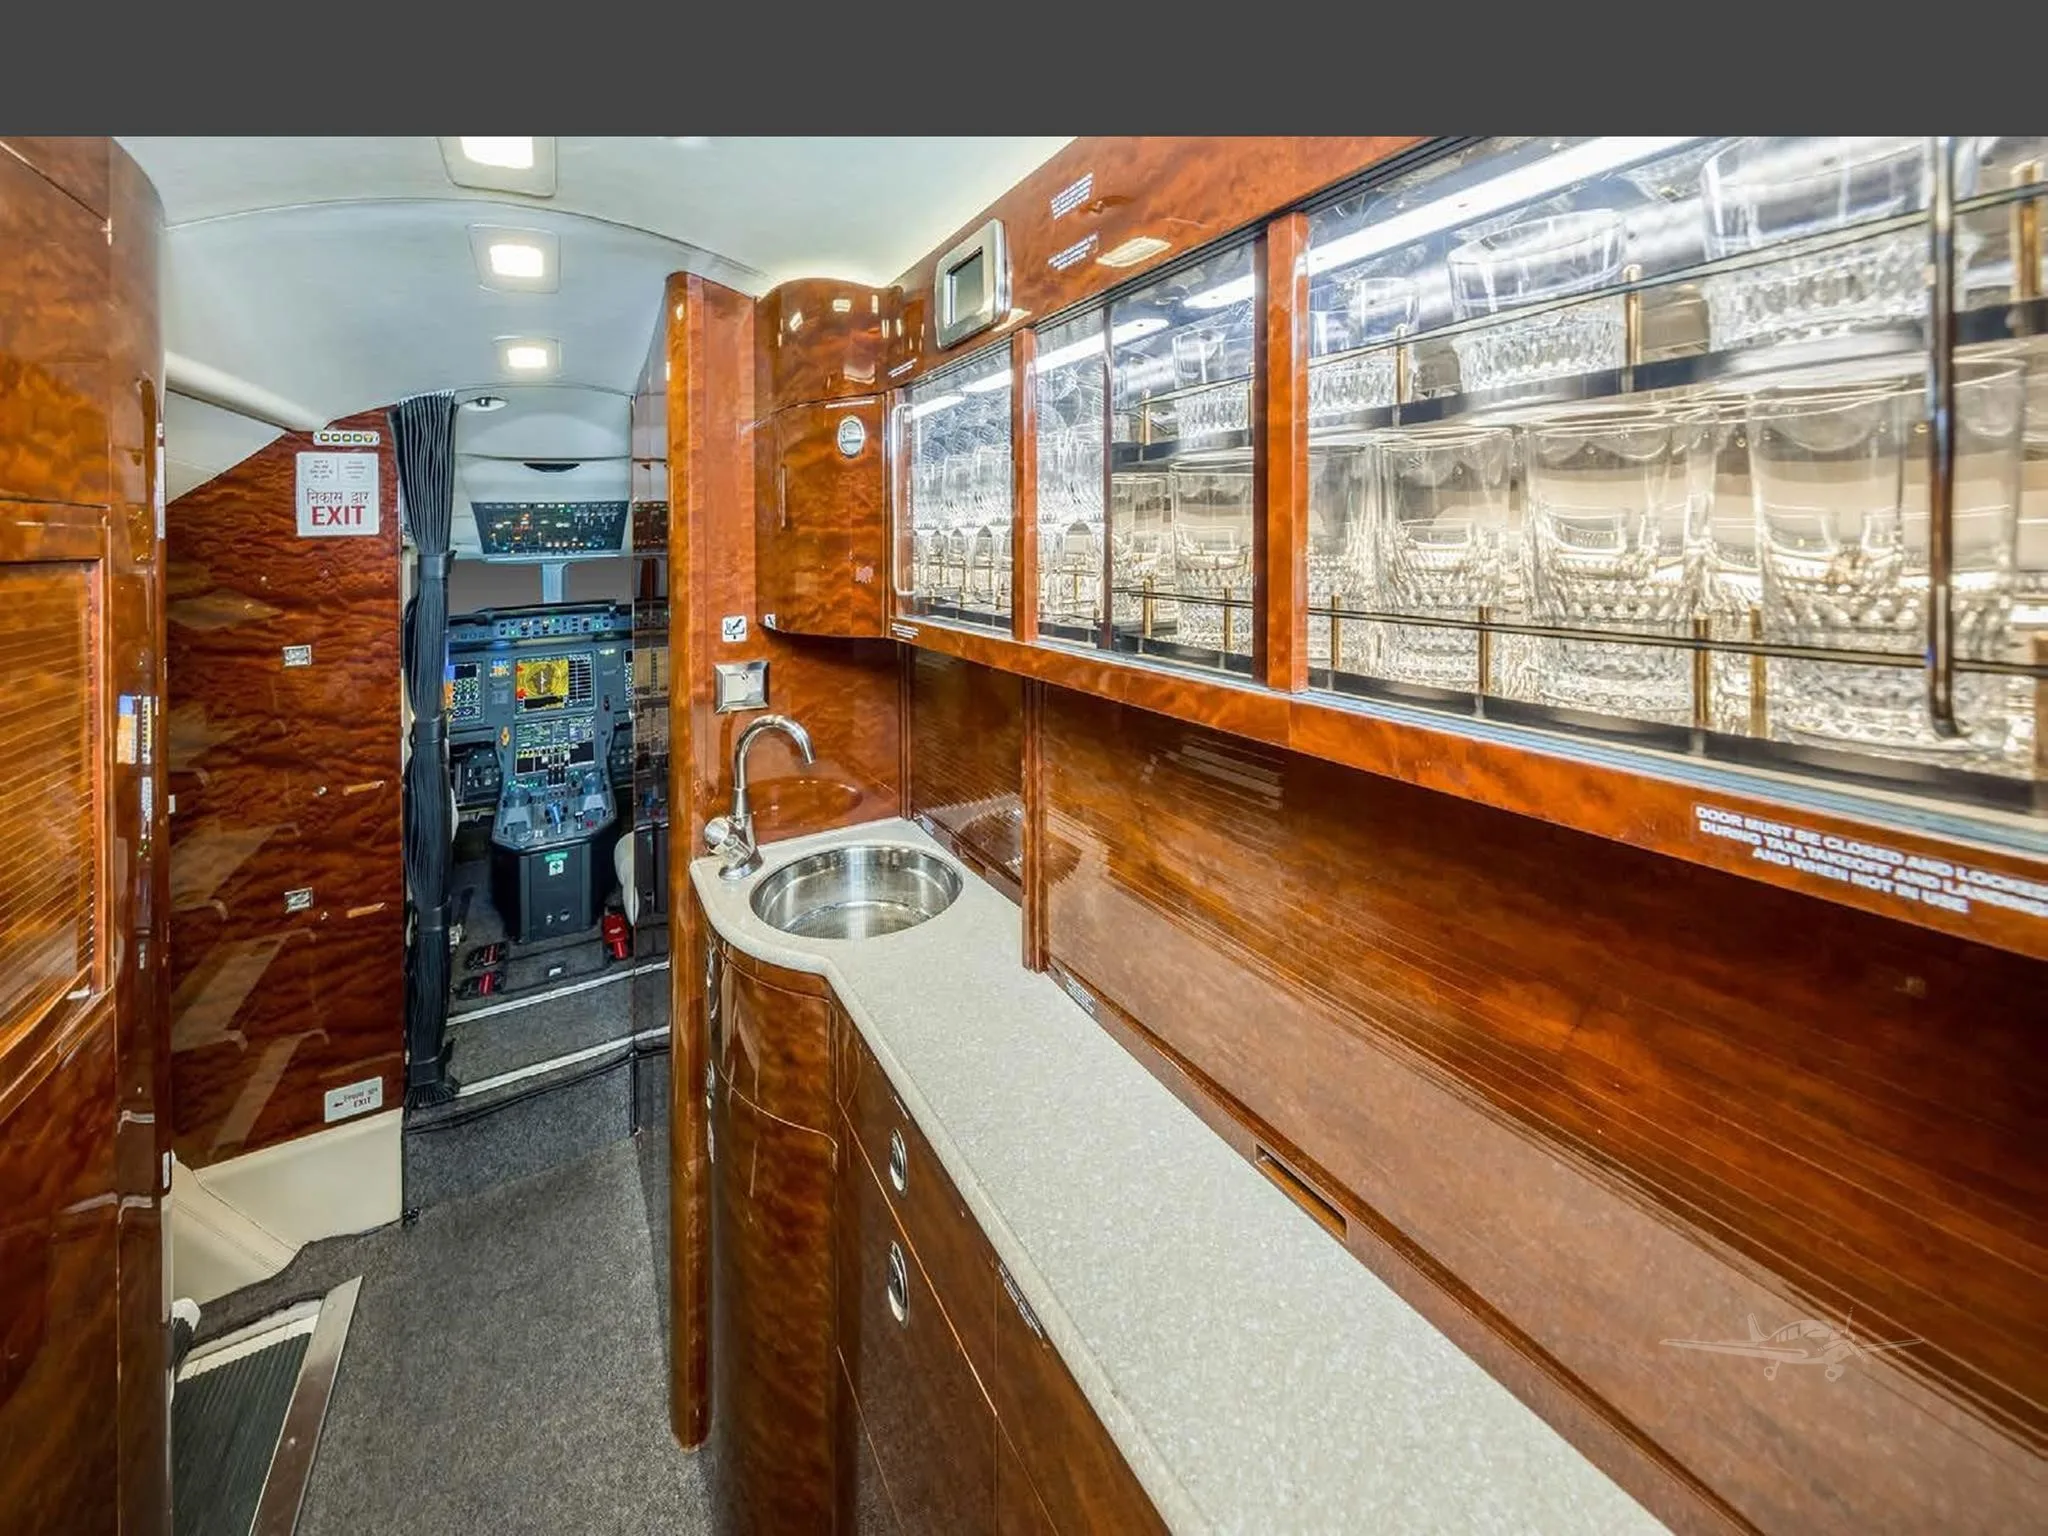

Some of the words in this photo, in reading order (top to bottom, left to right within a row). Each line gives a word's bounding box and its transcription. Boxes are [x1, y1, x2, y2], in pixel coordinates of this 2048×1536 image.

[312, 505, 366, 526] EXIT
[1695, 806, 1743, 827] DOOR
[1744, 818, 1792, 838] MUST
[1794, 829, 1821, 846] BE
[1822, 836, 1905, 865] CLOSED
[1905, 856, 1955, 877] AND
[1699, 820, 1762, 846] DURING
[1806, 846, 1893, 877] TAKEOFF
[1893, 868, 1942, 890] AND
[1752, 848, 1791, 866] AND
[1791, 856, 1849, 882] WHEN
[1850, 871, 1893, 893] NOT
[1894, 882, 1919, 900] IN
[1920, 890, 1970, 914] USE
[353, 1096, 371, 1108] EXIT
